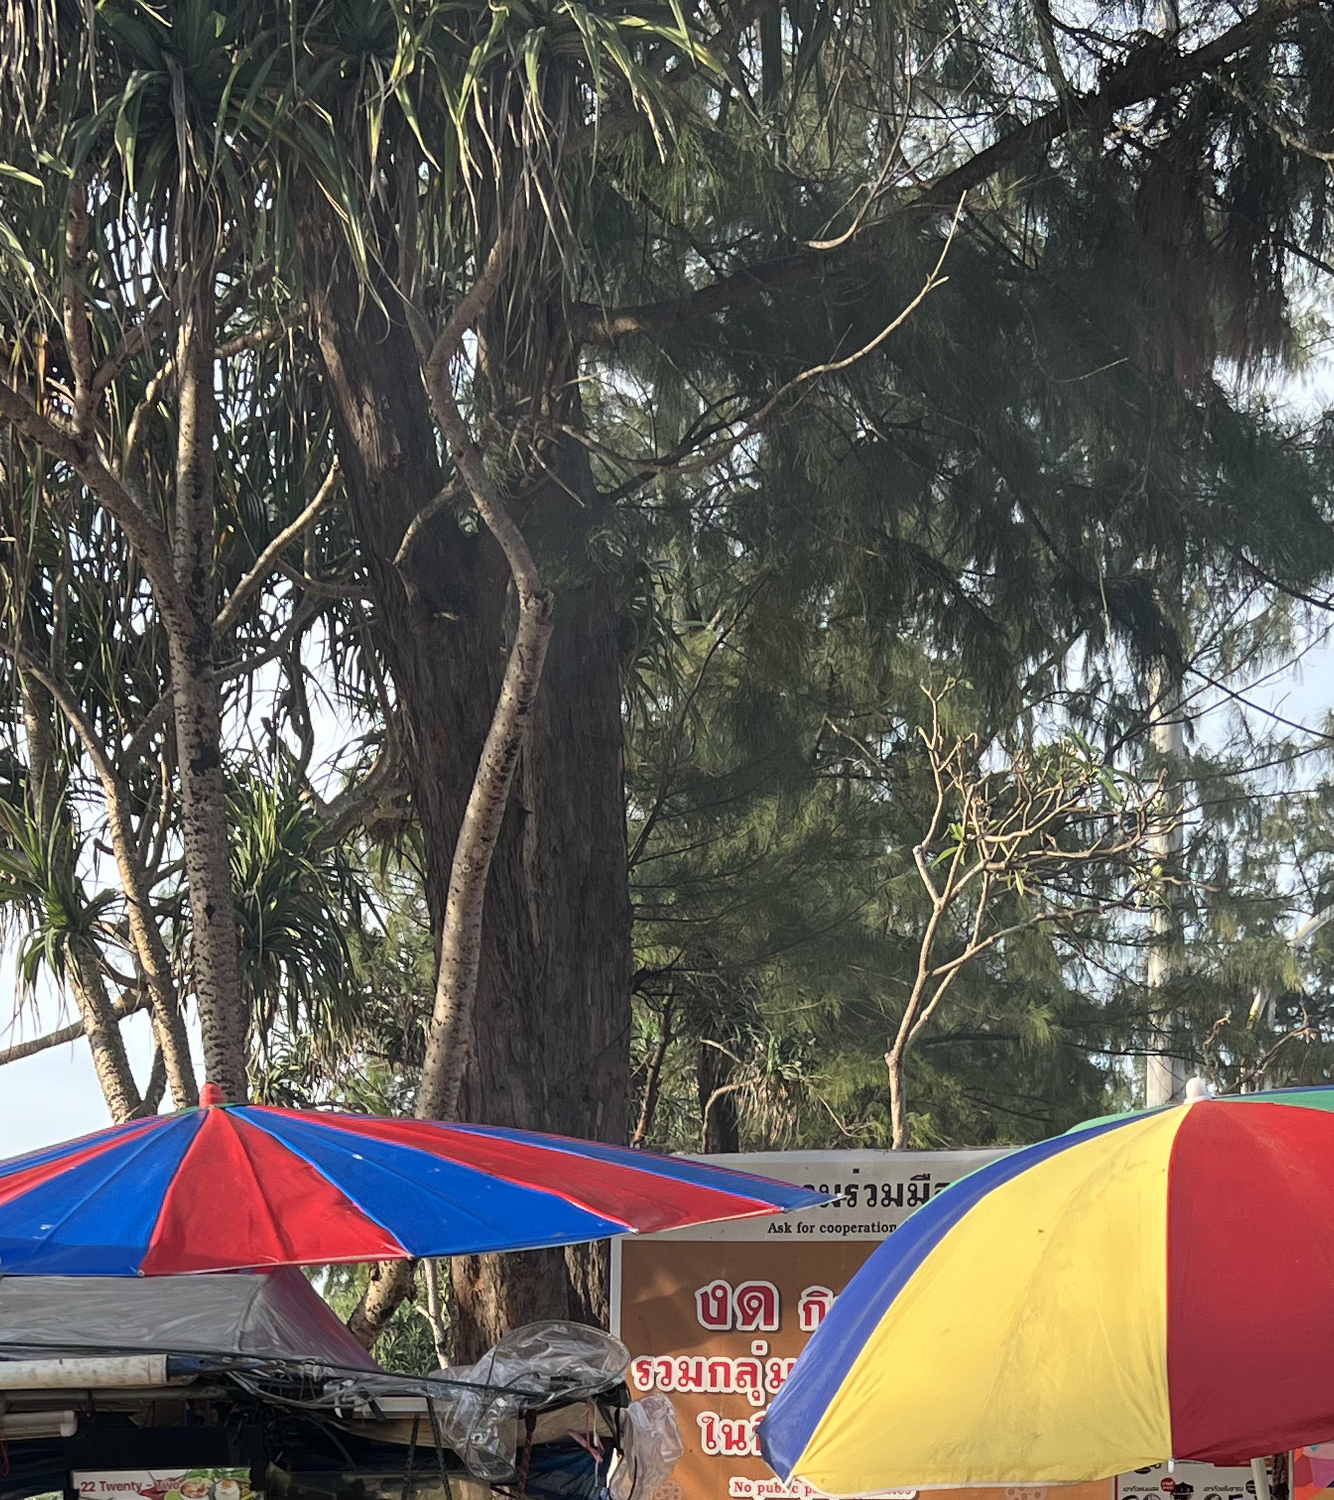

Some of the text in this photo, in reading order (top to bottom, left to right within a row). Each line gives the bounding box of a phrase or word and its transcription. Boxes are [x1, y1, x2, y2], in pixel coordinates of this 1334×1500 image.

[767, 1221, 897, 1237] Ask for cooperation
[699, 1283, 777, 1328] งด
[80, 1481, 96, 1492] 22
[99, 1480, 143, 1493] Twenty
[733, 1481, 752, 1493] No
